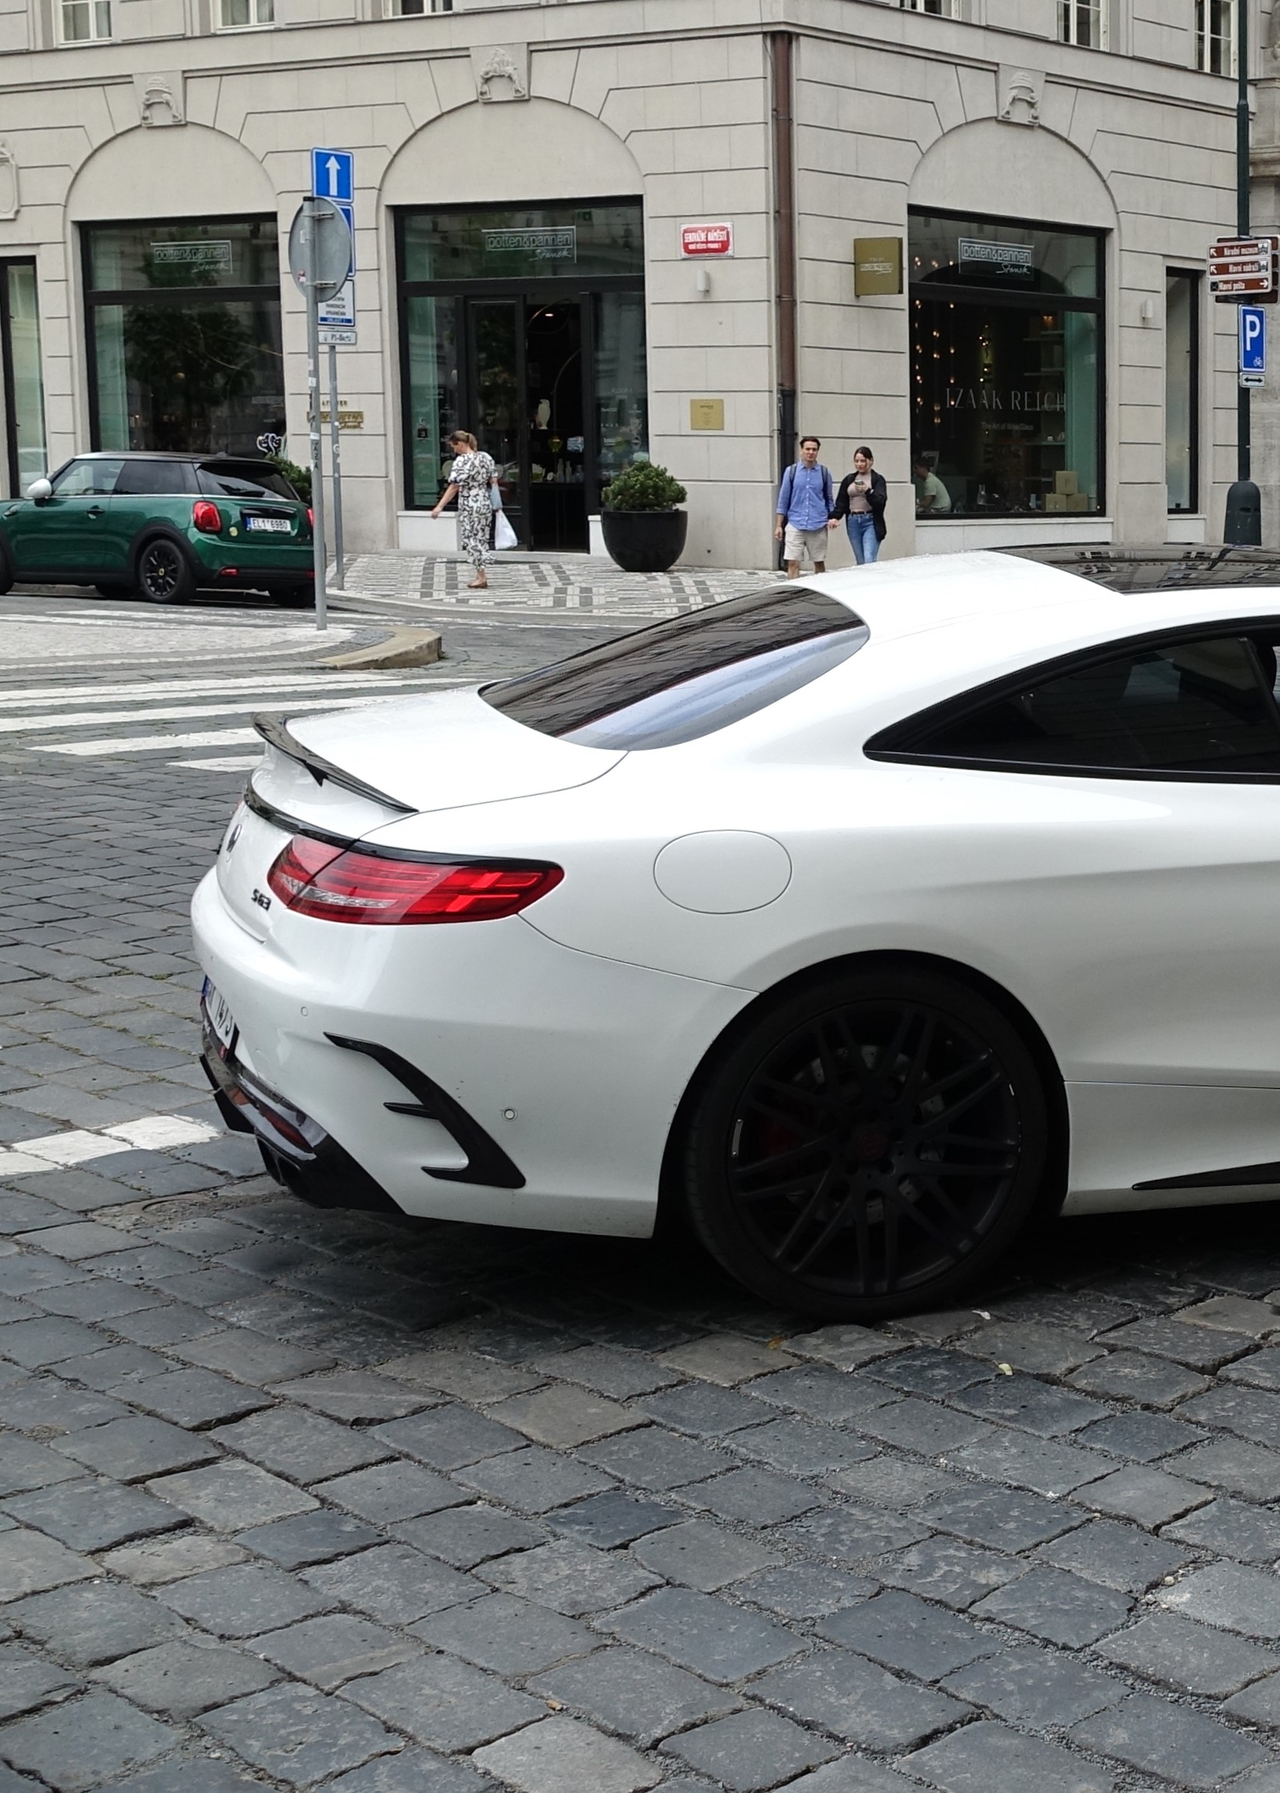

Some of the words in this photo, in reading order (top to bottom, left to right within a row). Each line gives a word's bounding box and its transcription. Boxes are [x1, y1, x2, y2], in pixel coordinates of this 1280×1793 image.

[487, 233, 571, 249] potten&pannen
[963, 245, 1030, 263] potten&pannen
[1245, 315, 1260, 351] P
[946, 388, 1003, 410] IZAAK
[1011, 390, 1067, 412] REICH
[251, 888, 271, 911] S63
